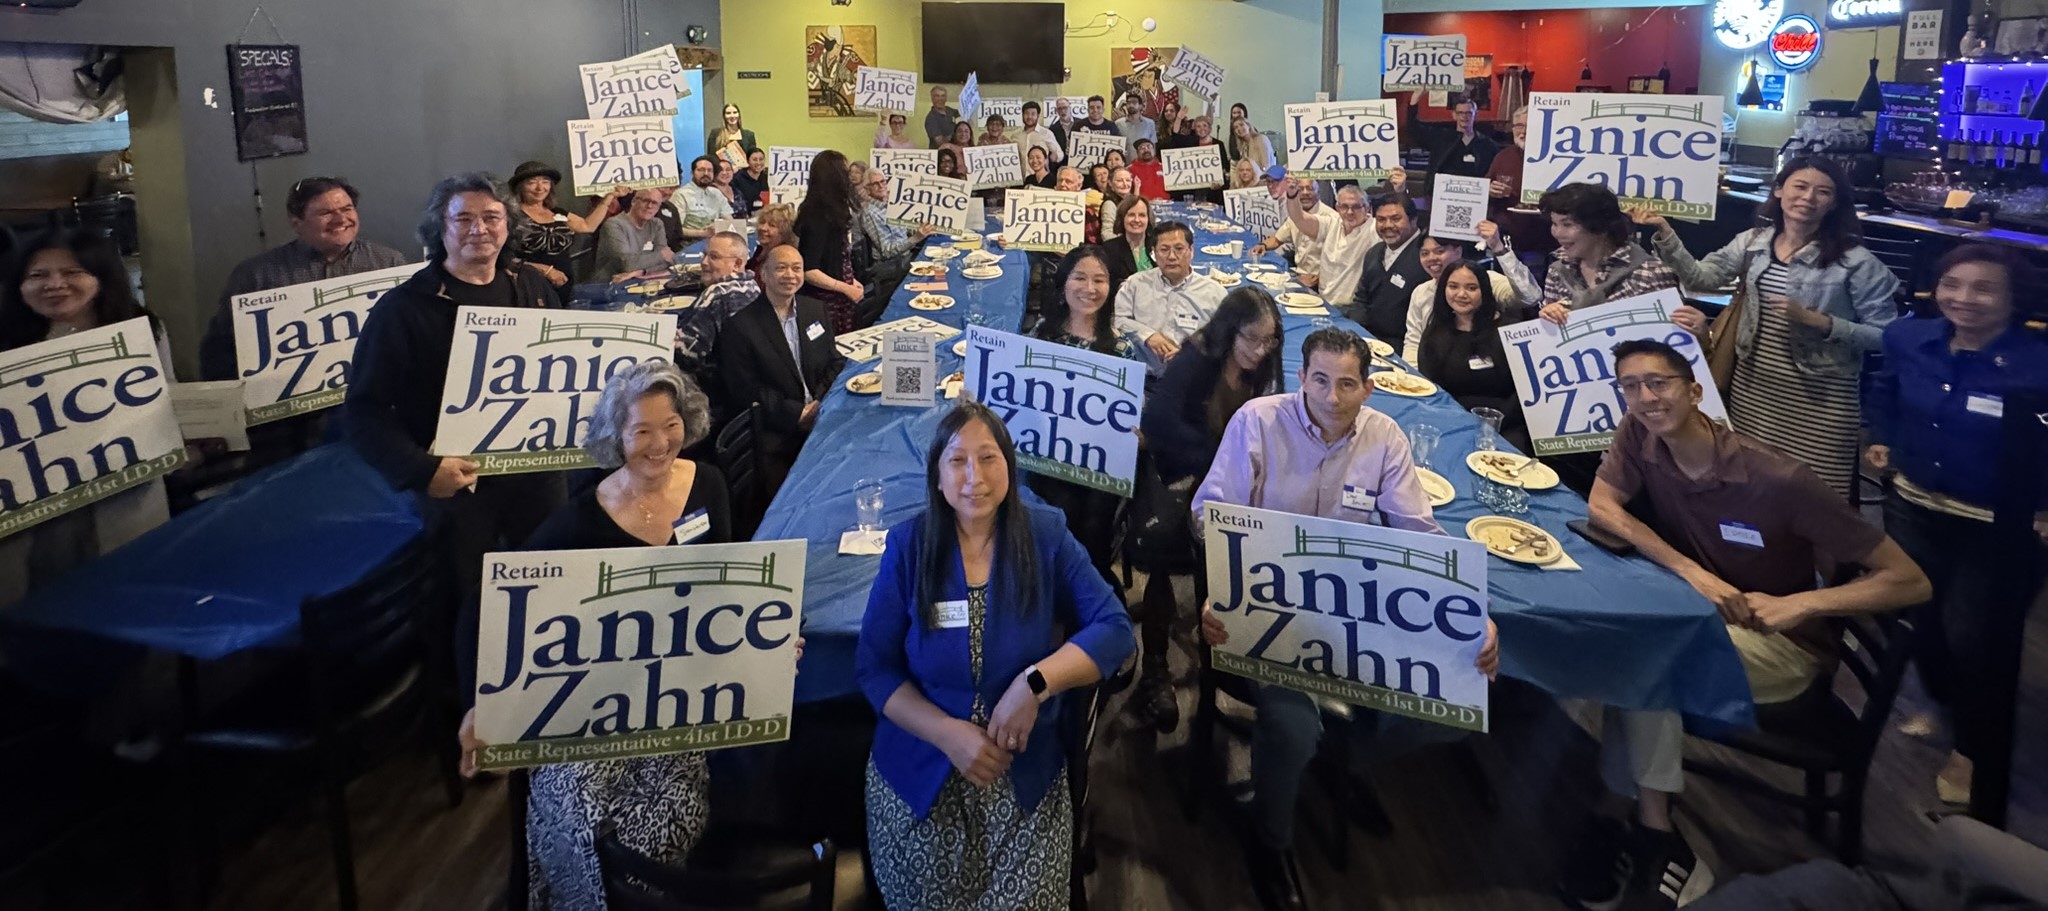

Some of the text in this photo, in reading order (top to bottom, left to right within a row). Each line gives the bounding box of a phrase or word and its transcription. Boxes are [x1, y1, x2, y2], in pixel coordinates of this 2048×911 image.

[1172, 51, 1223, 87] Janice
[1386, 45, 1464, 71] Janice
[588, 70, 672, 105] Janice
[857, 72, 915, 96] Janice
[1173, 67, 1209, 96] Zahn
[1395, 66, 1452, 85] Zahn
[600, 93, 665, 118] Zahn
[863, 91, 906, 111] Zahn
[1044, 101, 1087, 118] Jace
[1288, 107, 1311, 115] Retain
[1533, 96, 1571, 106] Retain
[1289, 115, 1395, 153] Janice
[1527, 108, 1717, 164] Janice
[575, 130, 673, 168] Janice
[1070, 138, 1106, 158] Jani
[1302, 143, 1383, 171] Zahn
[589, 157, 664, 185] Zahn
[769, 153, 809, 176] Jani
[966, 152, 1019, 174] Janice
[975, 167, 1015, 185] Zahn
[1164, 154, 1220, 176] Janice
[777, 171, 808, 186] Zah
[1172, 169, 1215, 186] Zahn
[889, 177, 968, 211] Janice
[1668, 201, 1688, 213] LD
[897, 201, 954, 229] Zahn
[1005, 198, 1084, 228] Janice
[1241, 201, 1280, 230] Janice
[1014, 222, 1073, 244] Zahn
[238, 292, 288, 310] Retain
[465, 312, 517, 328] Retain
[1503, 325, 1540, 341] Retain
[242, 290, 378, 378] Jan
[970, 329, 1006, 349] Retain
[274, 350, 352, 402] Za
[445, 330, 666, 414] Janic
[1513, 326, 1699, 407] Jane
[290, 391, 345, 411] Represe
[975, 345, 1138, 433] Janice
[1545, 382, 1628, 437] Za
[471, 393, 594, 454] Zah
[1538, 436, 1614, 451] State Represe
[484, 452, 584, 471] Representative
[82, 479, 119, 498] 41st
[123, 464, 152, 484] LD
[160, 453, 178, 469] D
[1209, 507, 1264, 530] Retain
[490, 562, 564, 582] Retain
[1212, 529, 1482, 641] Janice
[478, 582, 793, 695] Janice
[1244, 602, 1448, 702] Zahn
[517, 659, 750, 744] Zahn
[1219, 653, 1476, 724] State Representative 41st LD D
[484, 719, 781, 764] State Representative 41st LD D
